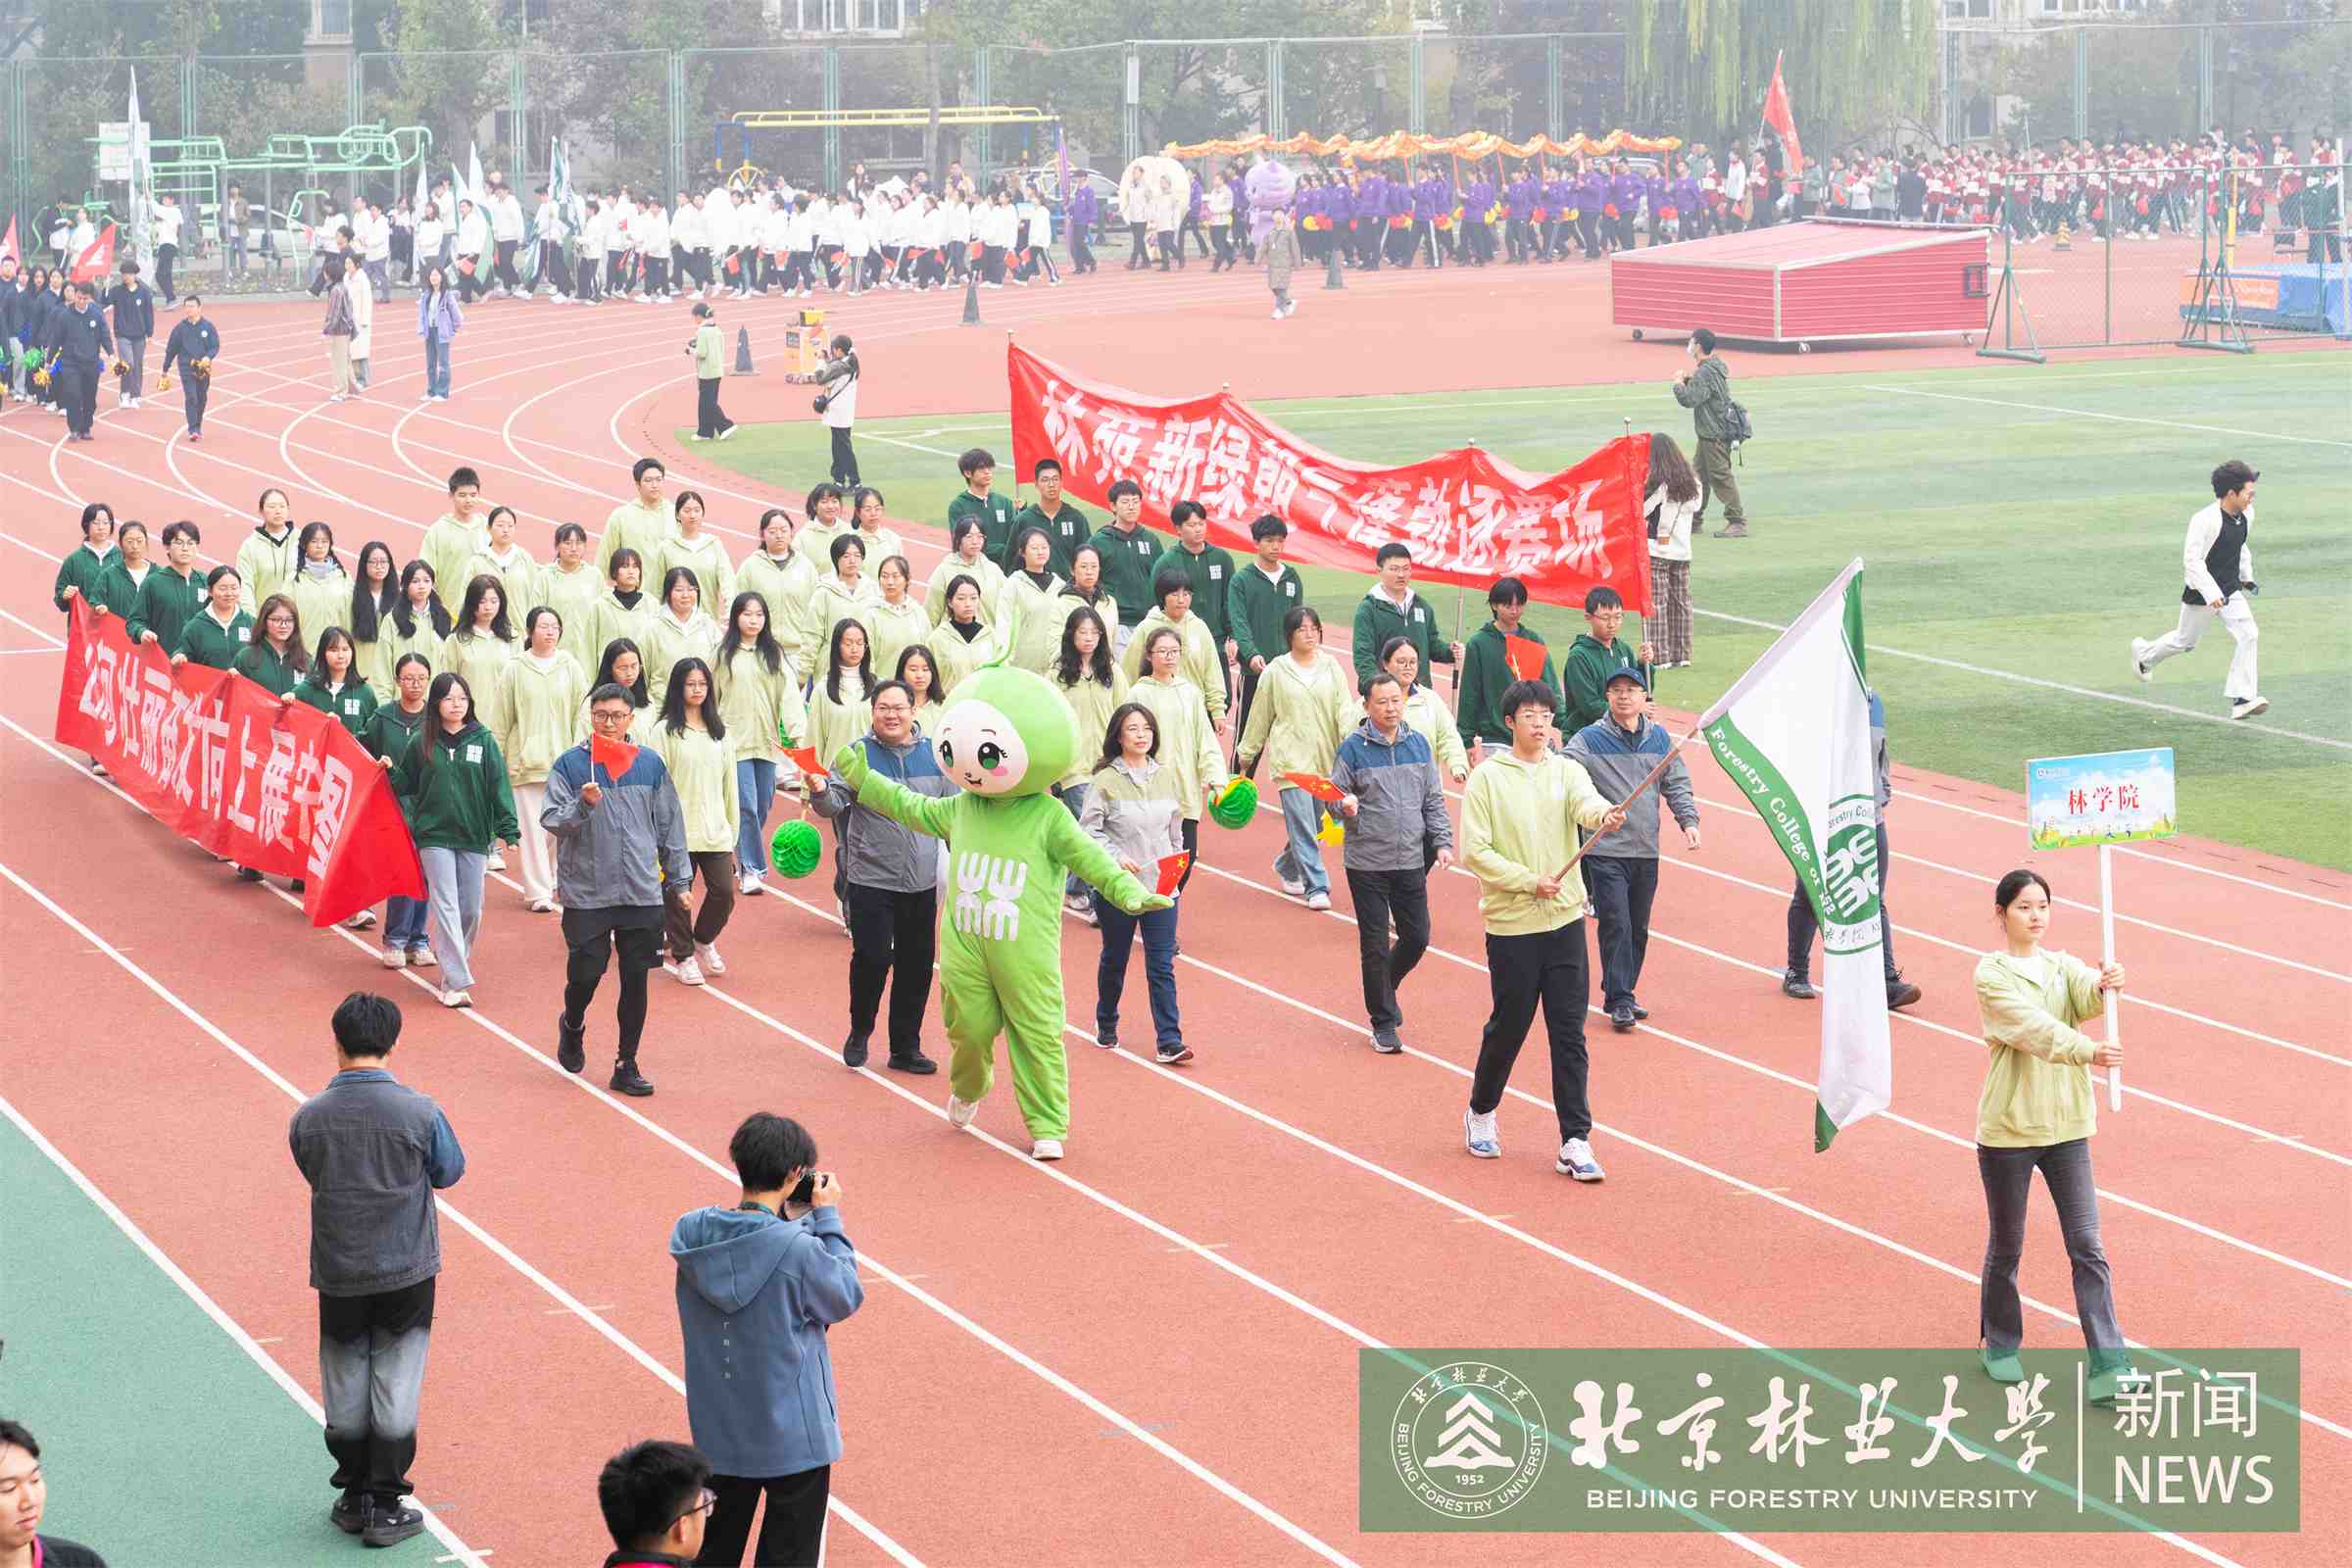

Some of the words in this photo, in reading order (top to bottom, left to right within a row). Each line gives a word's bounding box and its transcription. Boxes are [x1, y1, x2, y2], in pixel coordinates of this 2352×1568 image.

[1711, 728, 1770, 795] Forestry
[1770, 797, 1811, 862] College
[2069, 784, 2139, 815] 林学院
